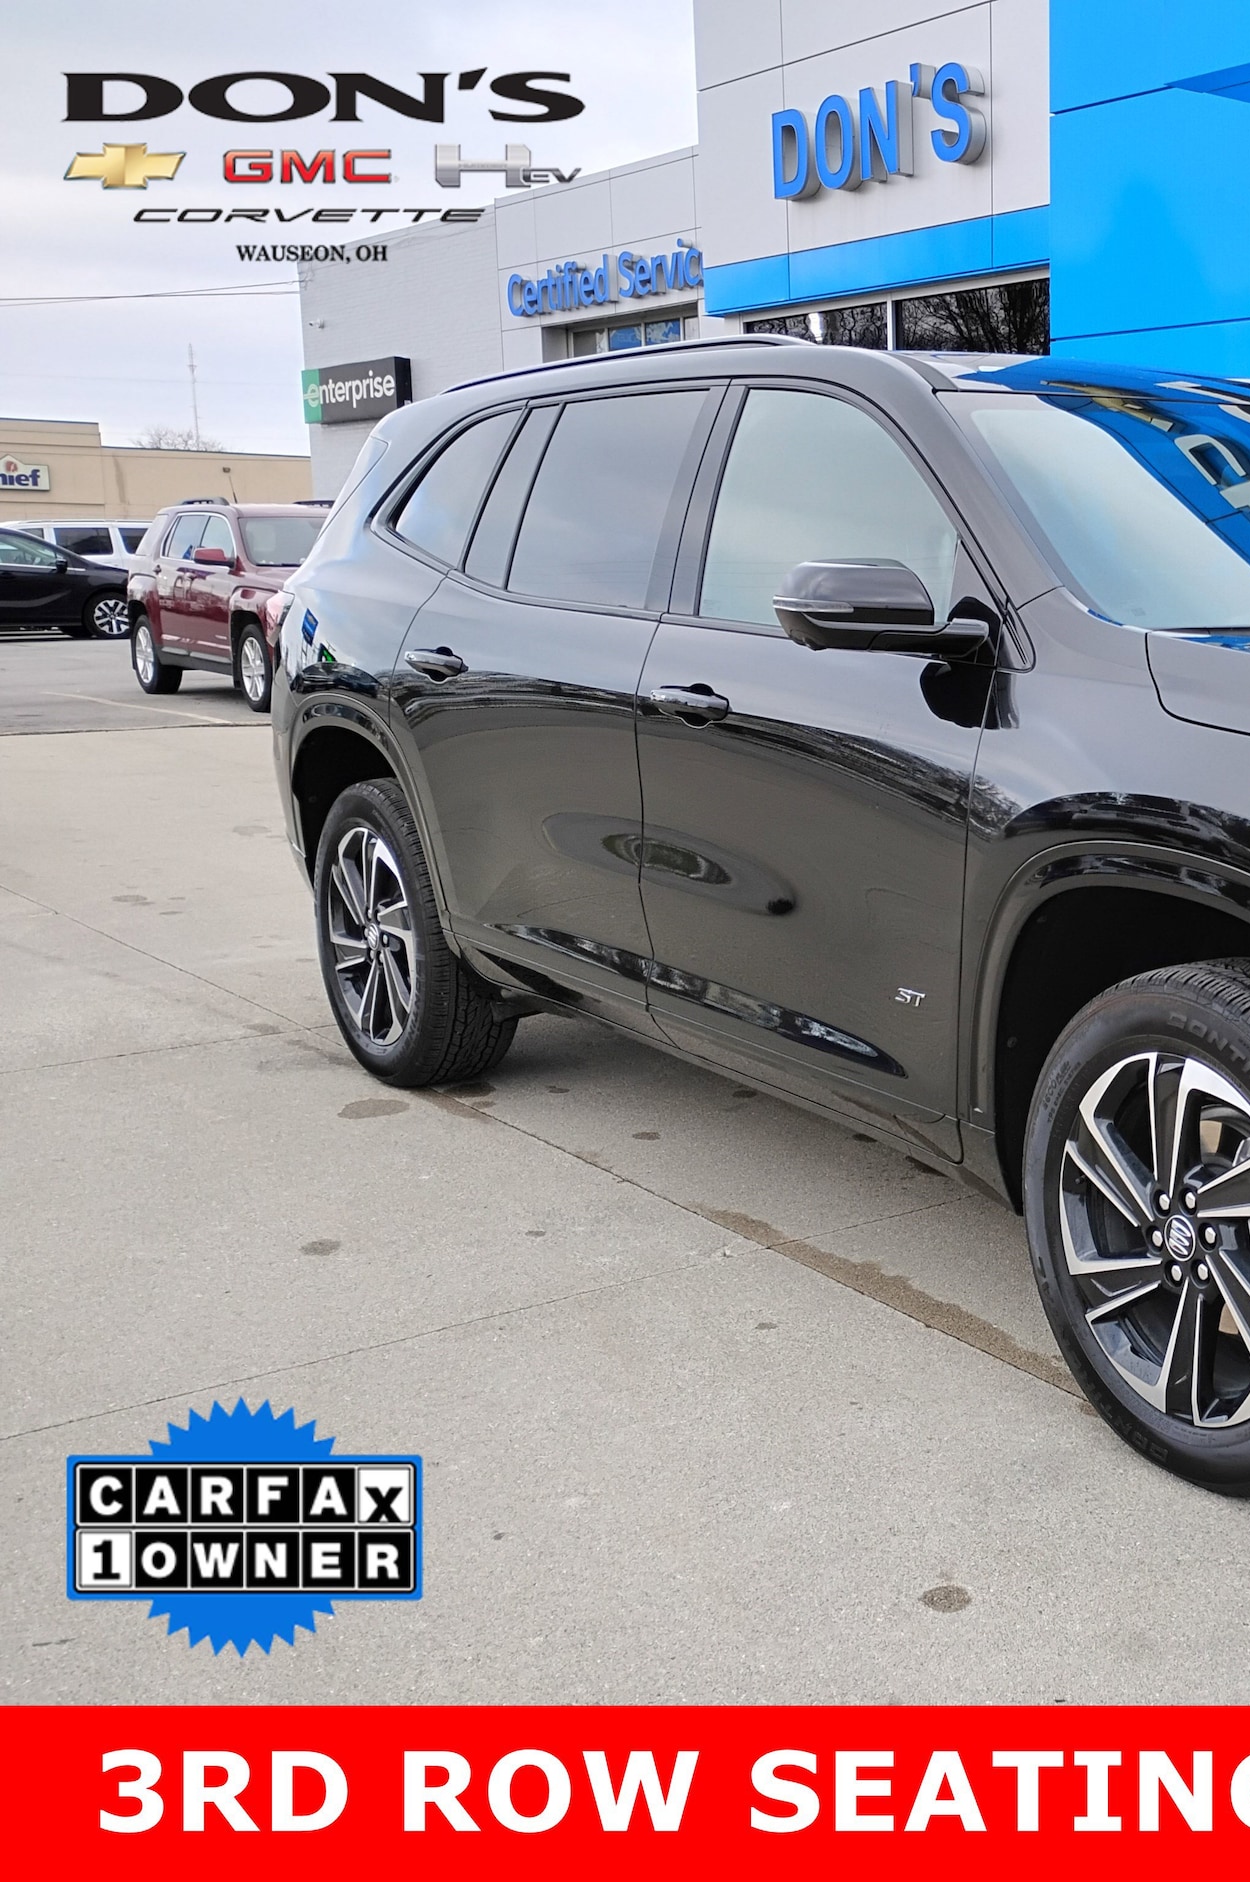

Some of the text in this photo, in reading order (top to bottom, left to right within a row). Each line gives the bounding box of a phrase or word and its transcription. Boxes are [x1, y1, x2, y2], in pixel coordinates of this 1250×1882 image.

[771, 61, 986, 202] DON'S
[507, 238, 704, 318] Certified Servic
[303, 369, 396, 409] enterprise
[894, 987, 926, 1008] ST
